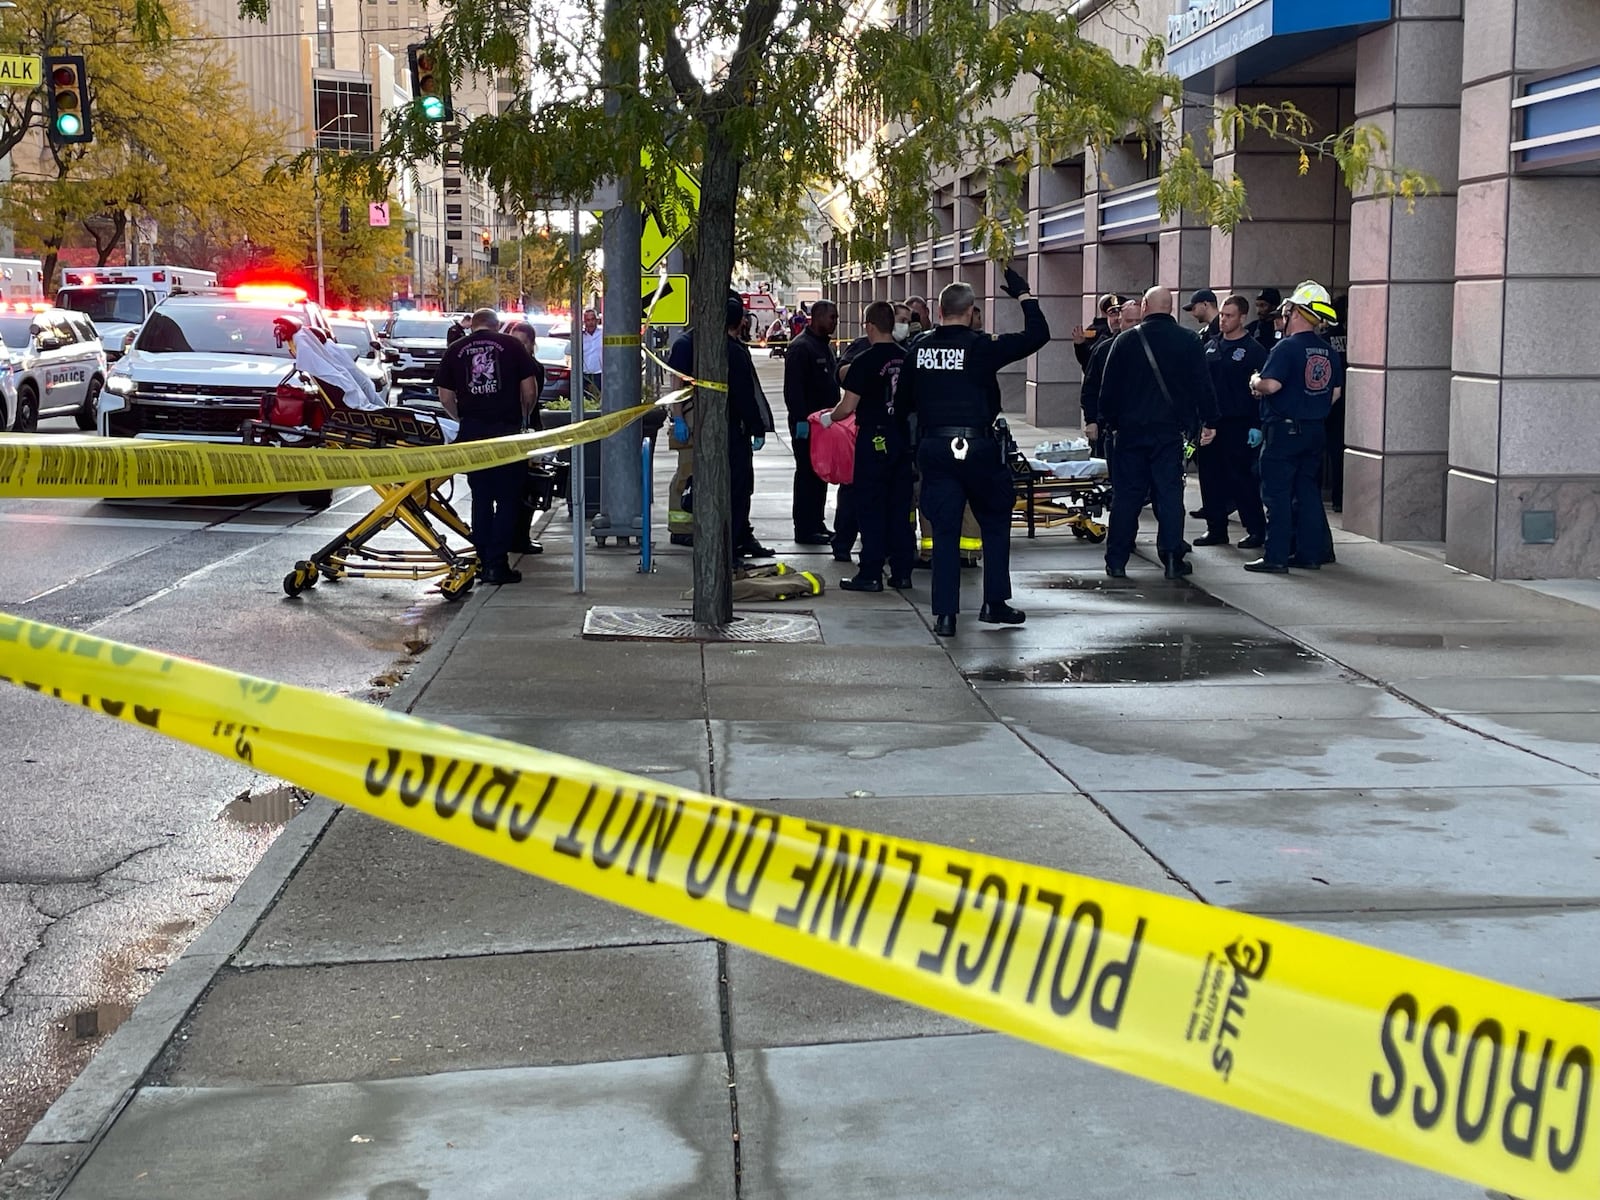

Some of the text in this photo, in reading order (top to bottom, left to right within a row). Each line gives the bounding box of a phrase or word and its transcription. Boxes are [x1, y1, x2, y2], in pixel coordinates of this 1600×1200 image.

[53, 371, 85, 383] POLICE
[471, 384, 497, 394] CURE
[917, 348, 965, 359] DAYTON
[917, 358, 964, 370] POLICE
[364, 748, 558, 842] CROSS
[553, 782, 684, 884] NOT
[685, 806, 782, 914] DO
[774, 825, 922, 959] LINE
[917, 863, 1147, 1032] POLICE
[1371, 992, 1593, 1173] CROSS
